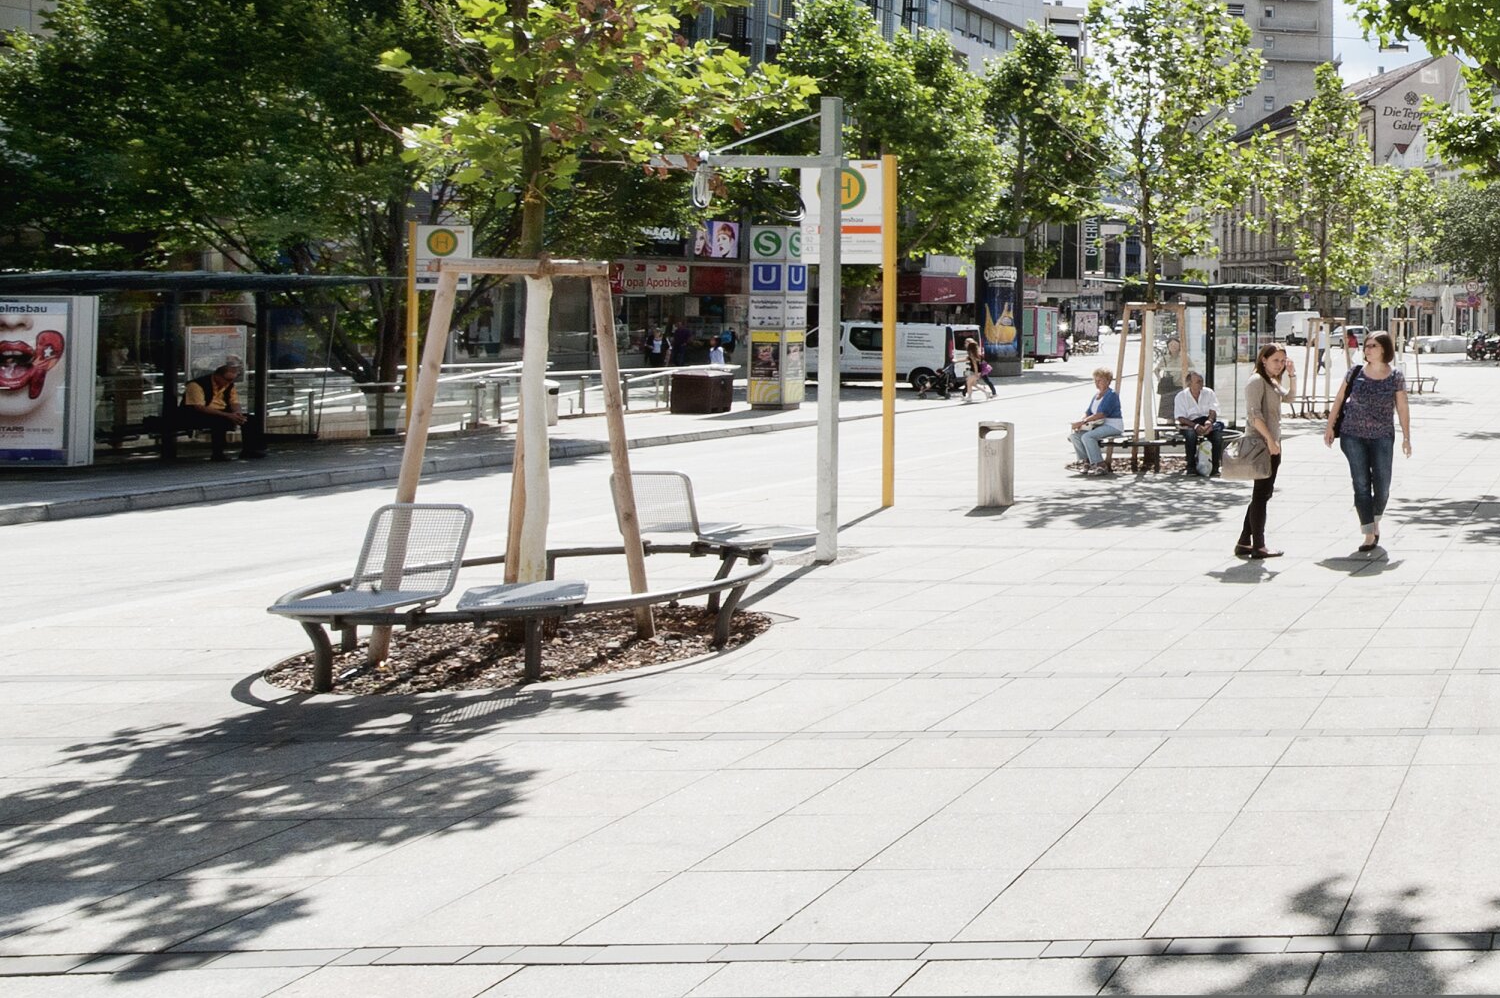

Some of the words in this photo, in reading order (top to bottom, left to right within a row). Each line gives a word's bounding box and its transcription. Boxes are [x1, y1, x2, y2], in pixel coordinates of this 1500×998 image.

[1383, 106, 1401, 117] Die
[758, 232, 777, 255] S
[1085, 216, 1098, 257] GALERIA
[646, 277, 688, 289] Apotheke
[758, 265, 777, 284] U
[791, 266, 803, 285] U
